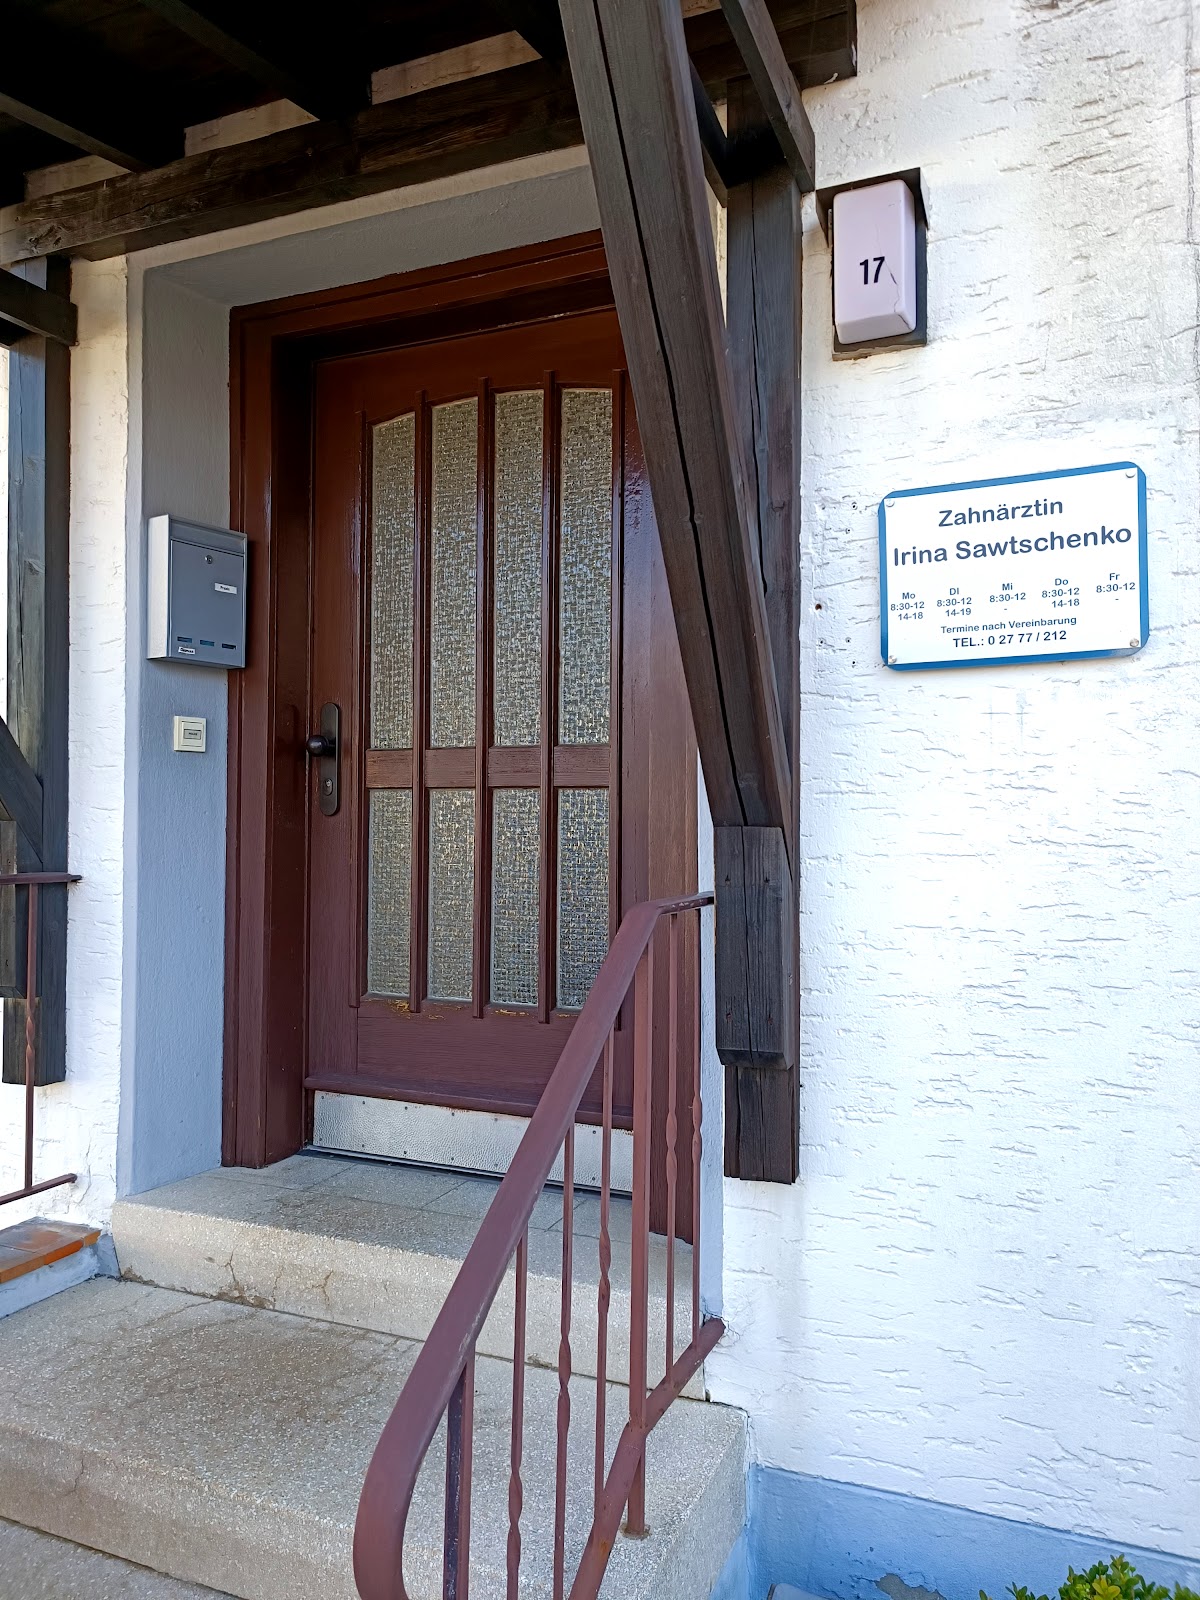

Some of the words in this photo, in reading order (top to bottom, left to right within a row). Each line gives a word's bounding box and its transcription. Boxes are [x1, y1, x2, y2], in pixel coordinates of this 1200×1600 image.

[859, 256, 886, 286] 17
[938, 498, 1063, 527] Zahnärztin
[893, 546, 948, 567] Irina
[955, 525, 1132, 560] Sawtschenko
[890, 601, 925, 612] 8:30-12
[936, 597, 972, 608] 8:30-12
[989, 592, 1026, 603] 8:30-12
[1041, 587, 1080, 599] 8:30-12
[1095, 582, 1136, 594] 8:30-12
[902, 592, 916, 600] Mo
[1001, 583, 1013, 591] Mi
[1054, 578, 1069, 586] Do
[1109, 572, 1120, 581] Fr
[898, 612, 924, 621] 14-18
[945, 607, 972, 617] 14-19
[1051, 598, 1080, 608] 14-18
[940, 624, 980, 634] Termine
[982, 621, 1006, 631] nach
[1008, 617, 1077, 629] Vereinbarung
[952, 637, 984, 648] TEL.:
[987, 635, 996, 646] 0
[998, 634, 1014, 645] 27
[1018, 632, 1033, 644] 77
[1035, 631, 1041, 643] /
[1043, 630, 1067, 642] 212
